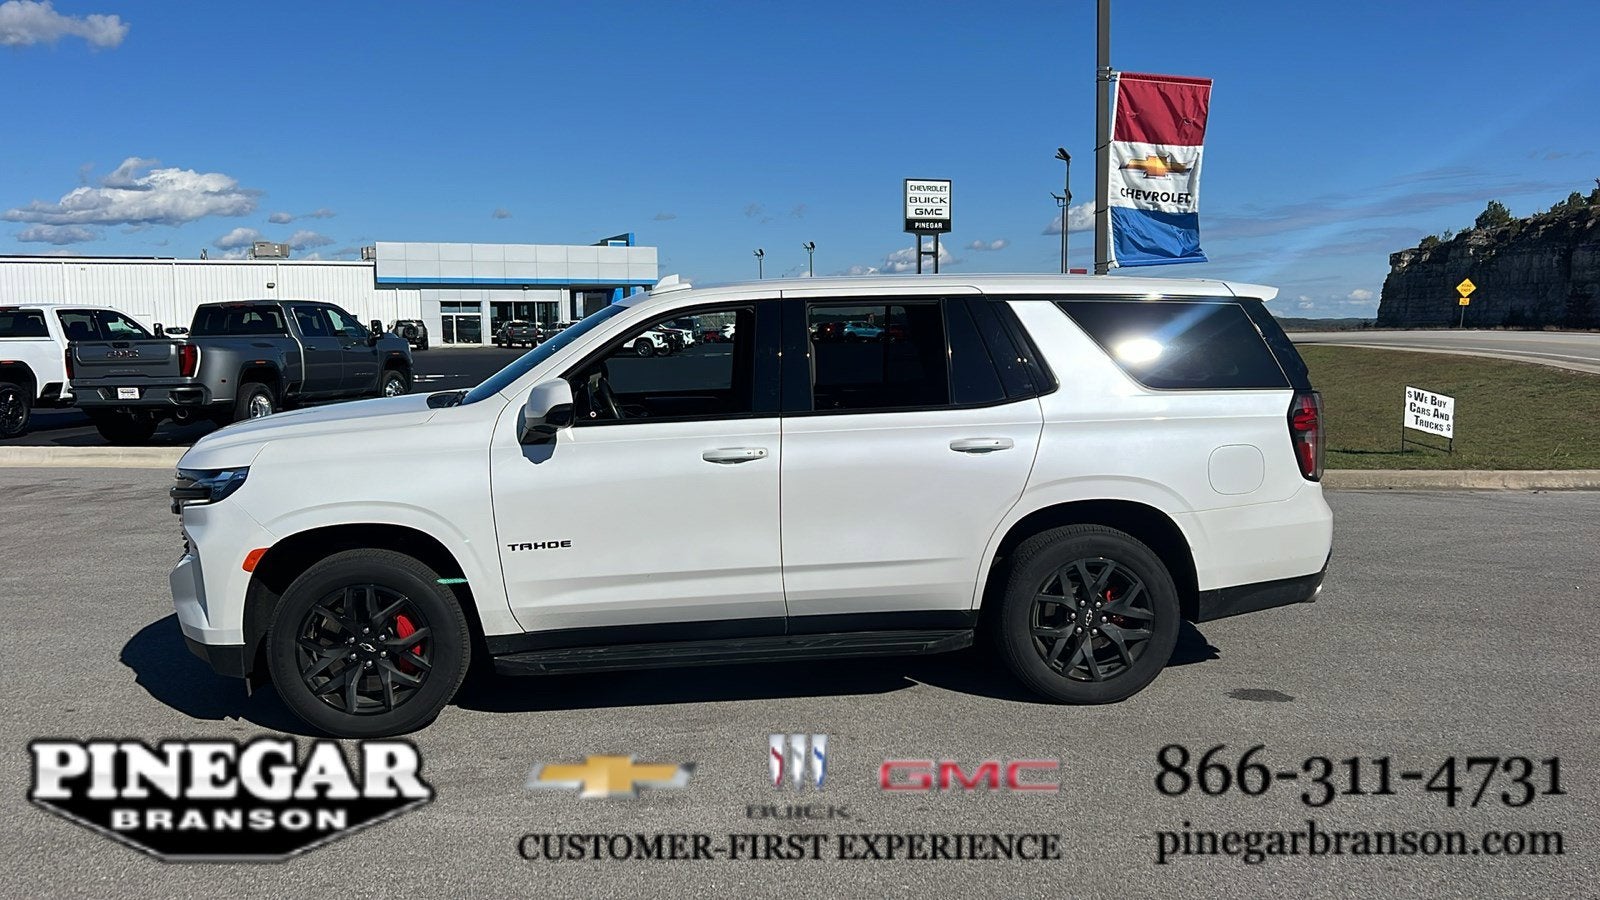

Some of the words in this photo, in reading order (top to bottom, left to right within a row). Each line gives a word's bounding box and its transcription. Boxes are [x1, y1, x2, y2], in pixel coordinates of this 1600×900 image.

[909, 196, 948, 204] BUICK
[1120, 187, 1191, 203] CHEVROLET
[914, 208, 943, 216] GMC
[507, 540, 572, 552] TAHOE
